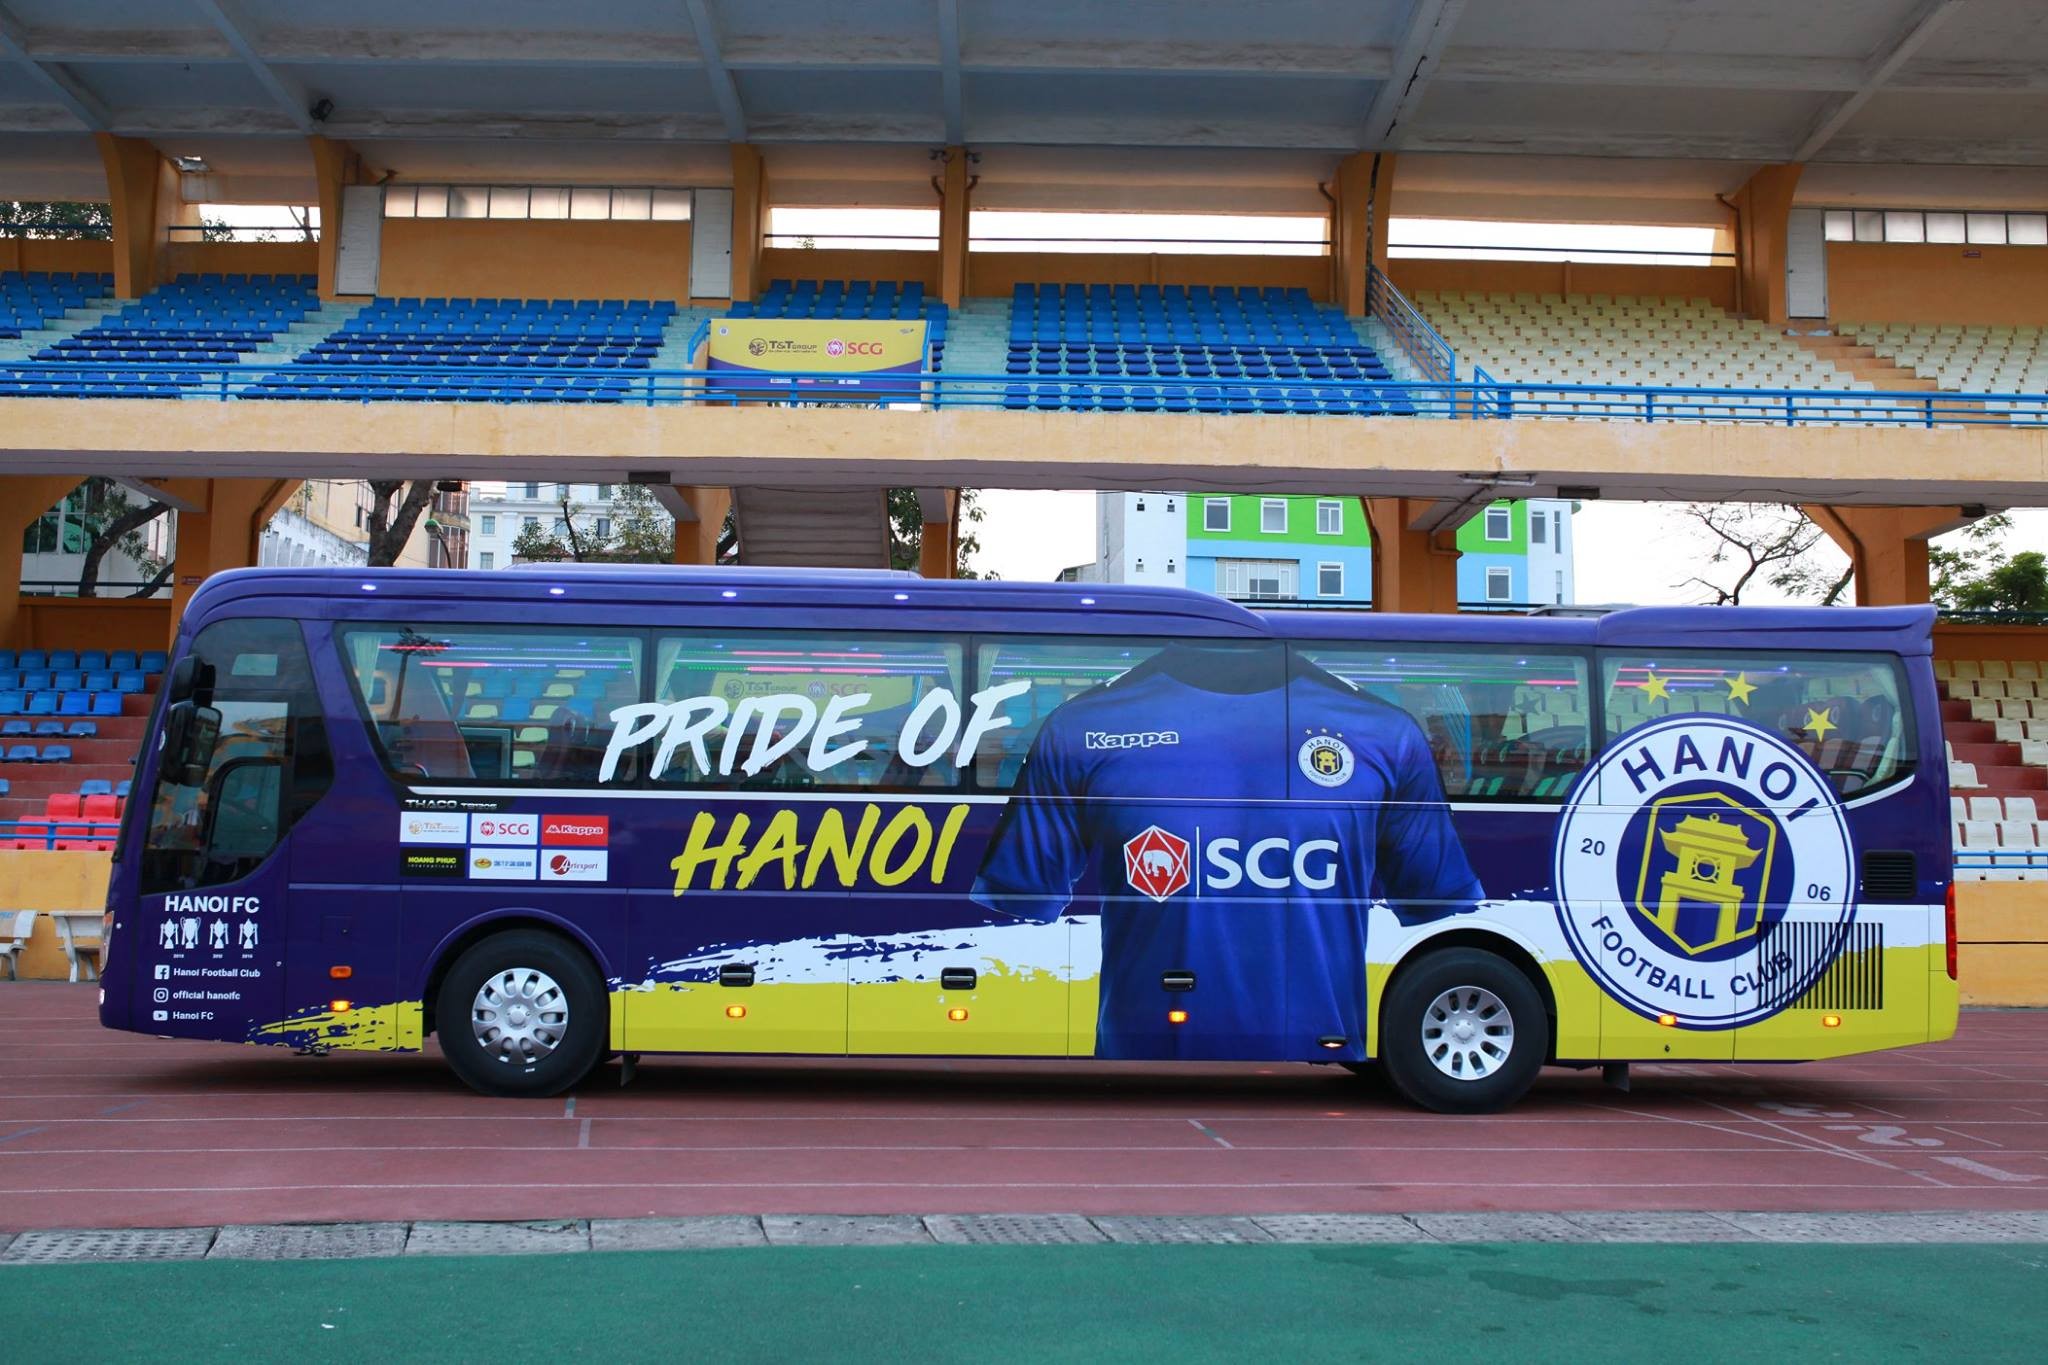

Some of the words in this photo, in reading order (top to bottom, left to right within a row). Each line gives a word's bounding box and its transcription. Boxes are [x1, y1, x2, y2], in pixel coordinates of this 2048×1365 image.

[847, 342, 883, 355] SCG
[598, 692, 872, 783] PRIDE
[898, 680, 1032, 769] OF
[1086, 731, 1179, 749] Kappa
[1307, 739, 1344, 751] HANOI
[1621, 734, 1820, 822] HANOI
[405, 800, 457, 809] THACO
[498, 823, 530, 836] SCG
[561, 824, 604, 836] Kappa
[671, 804, 970, 897] HANOI
[1580, 837, 1605, 856] 20
[1206, 837, 1339, 890] SCG
[1807, 883, 1831, 902] 06
[165, 895, 228, 913] HANOI
[232, 897, 260, 914] FC
[1591, 915, 1715, 999] FOOTBALL
[173, 968, 200, 977] Hanoi
[201, 968, 238, 978] Football
[240, 969, 261, 978] Club
[1730, 951, 1793, 996] CLUB
[172, 990, 204, 1000] official
[173, 1011, 199, 1020] Hanoi
[201, 1011, 214, 1020] FC
